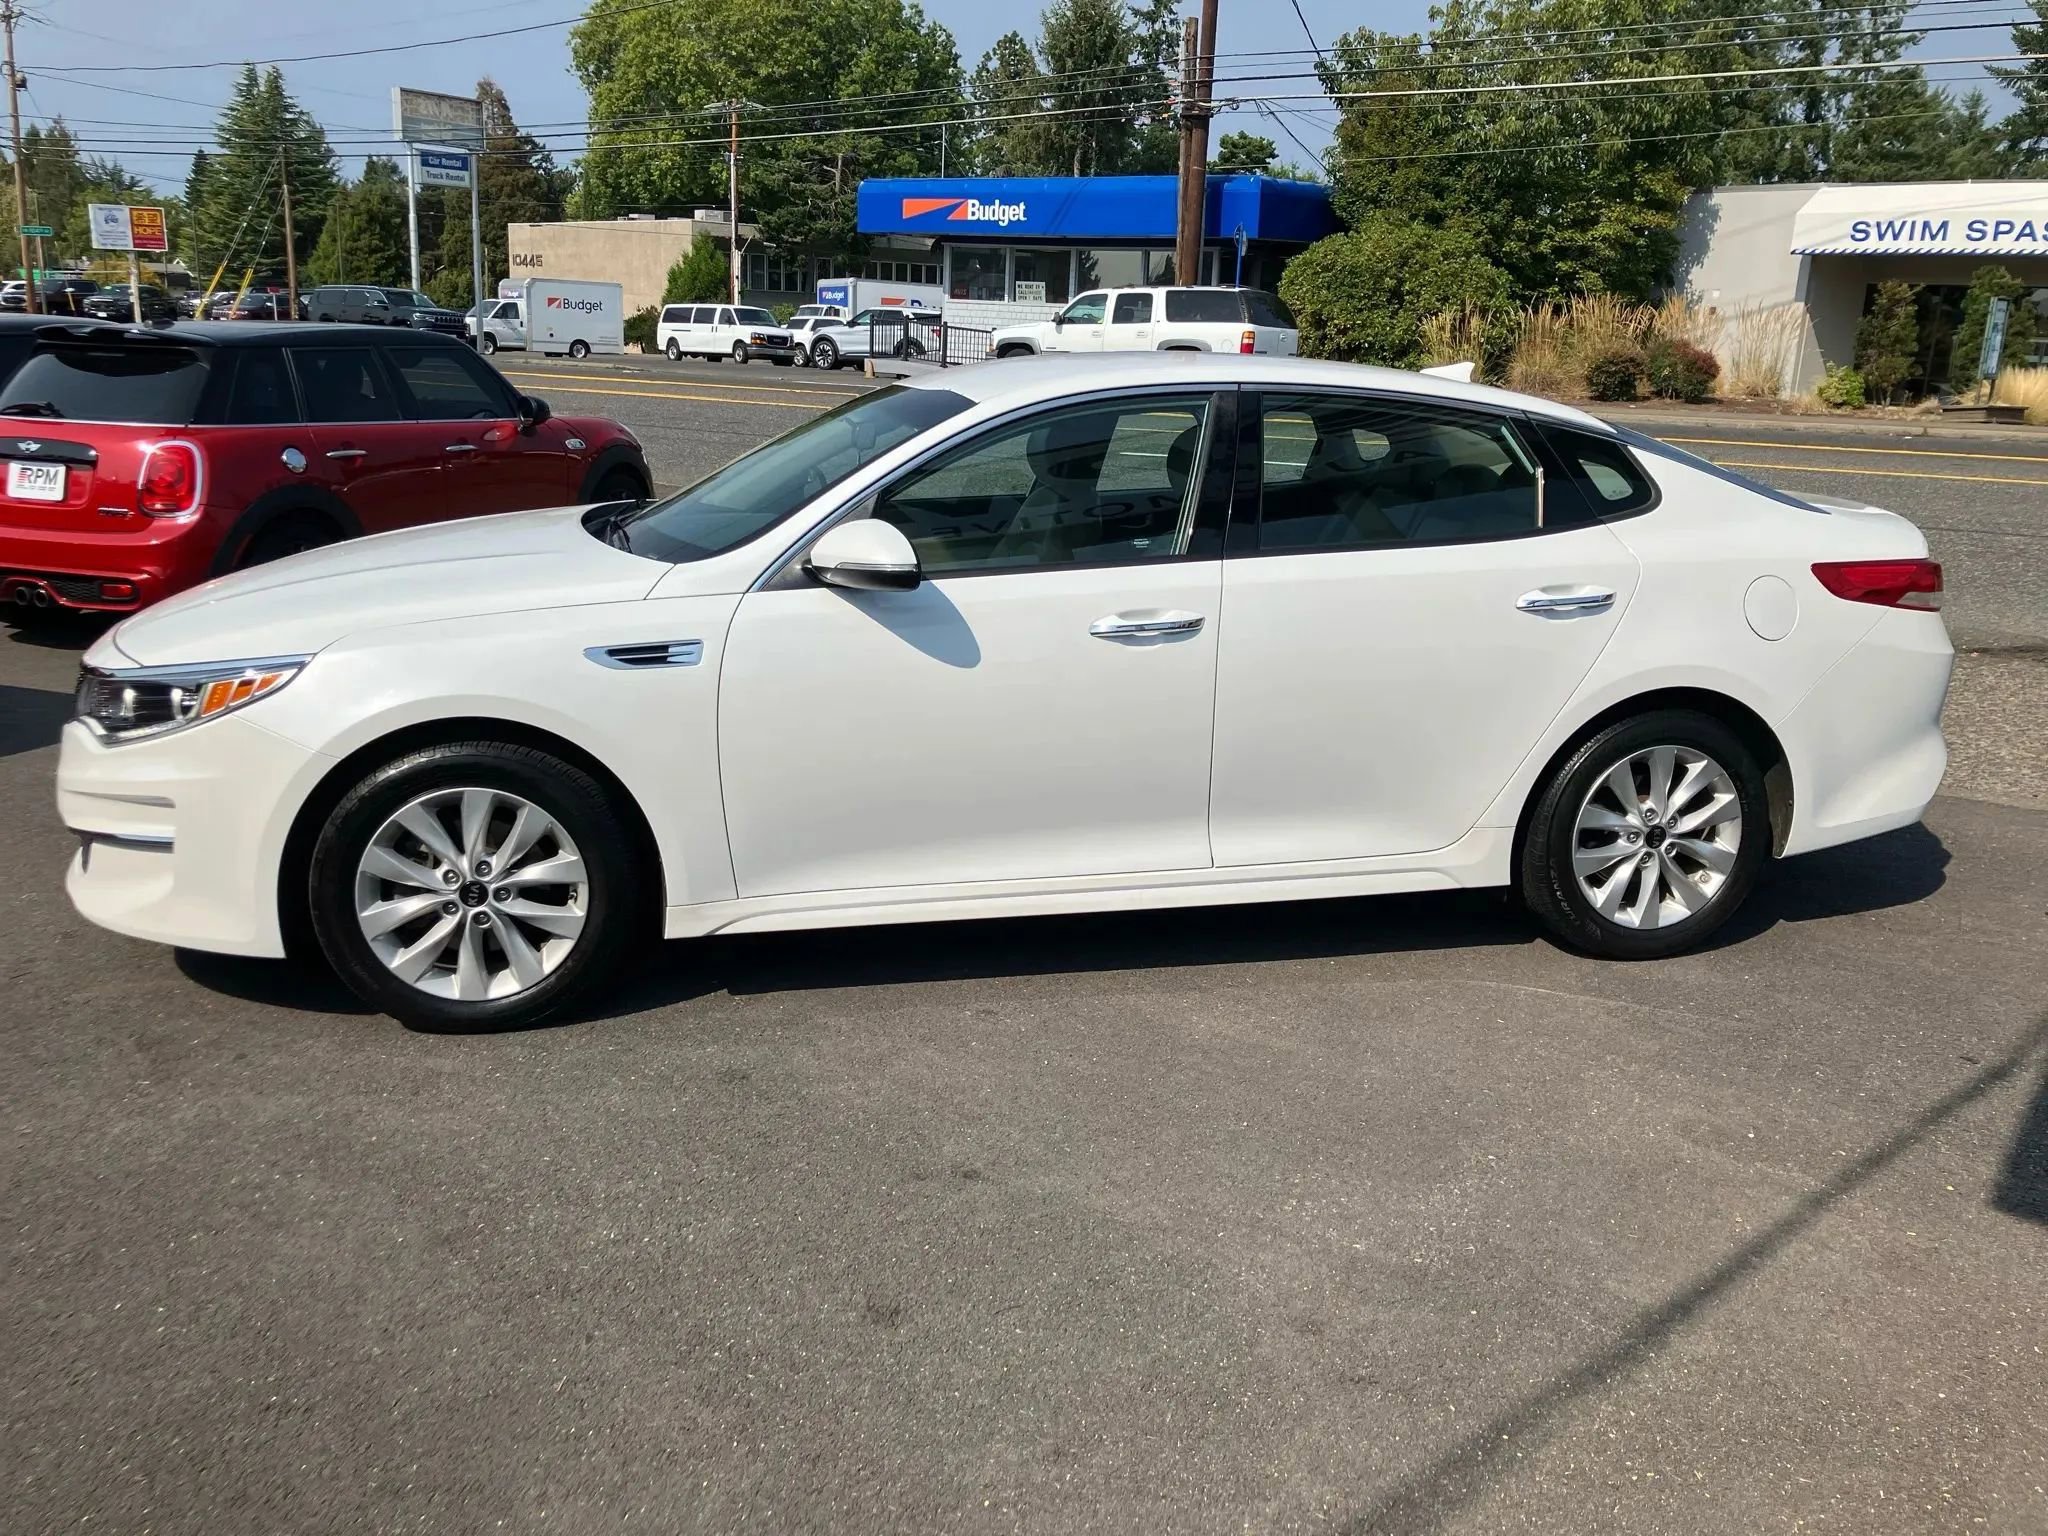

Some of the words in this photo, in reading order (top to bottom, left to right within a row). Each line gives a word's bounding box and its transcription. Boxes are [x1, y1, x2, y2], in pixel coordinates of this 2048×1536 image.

[428, 156, 440, 166] Car
[441, 157, 462, 167] Rental
[425, 170, 444, 180] Truck
[445, 172, 466, 182] Rental
[967, 199, 1028, 227] Budget
[135, 226, 162, 236] HOPE
[1850, 219, 1950, 242] SWIM
[1965, 219, 2048, 242] SPA
[828, 290, 845, 301] Budget
[563, 298, 603, 314] Budget
[17, 467, 59, 486] RPM
[467, 884, 481, 906] KIA
